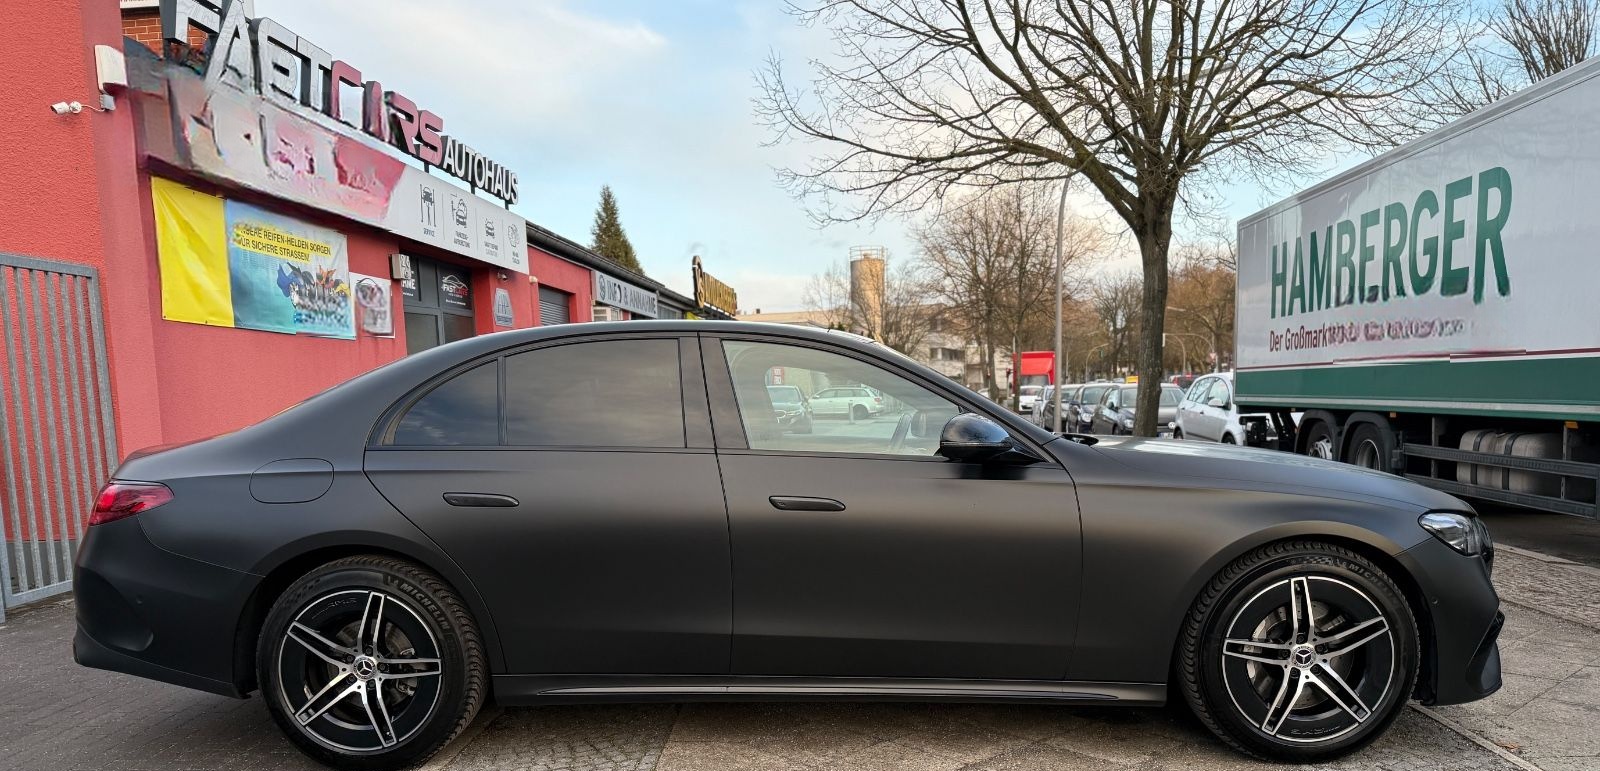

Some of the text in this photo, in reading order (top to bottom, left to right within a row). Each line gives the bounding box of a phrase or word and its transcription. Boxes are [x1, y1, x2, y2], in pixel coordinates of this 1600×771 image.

[442, 135, 519, 206] AUTOHAUS
[251, 240, 279, 255] SICHERE
[263, 230, 309, 250] REIFEN-HELDEN
[309, 242, 332, 256] SORGEN
[1270, 166, 1513, 320] HAMBERGER
[1269, 330, 1283, 352] Der
[1285, 322, 1332, 350] Großmark
[400, 583, 450, 630] MICHELIN
